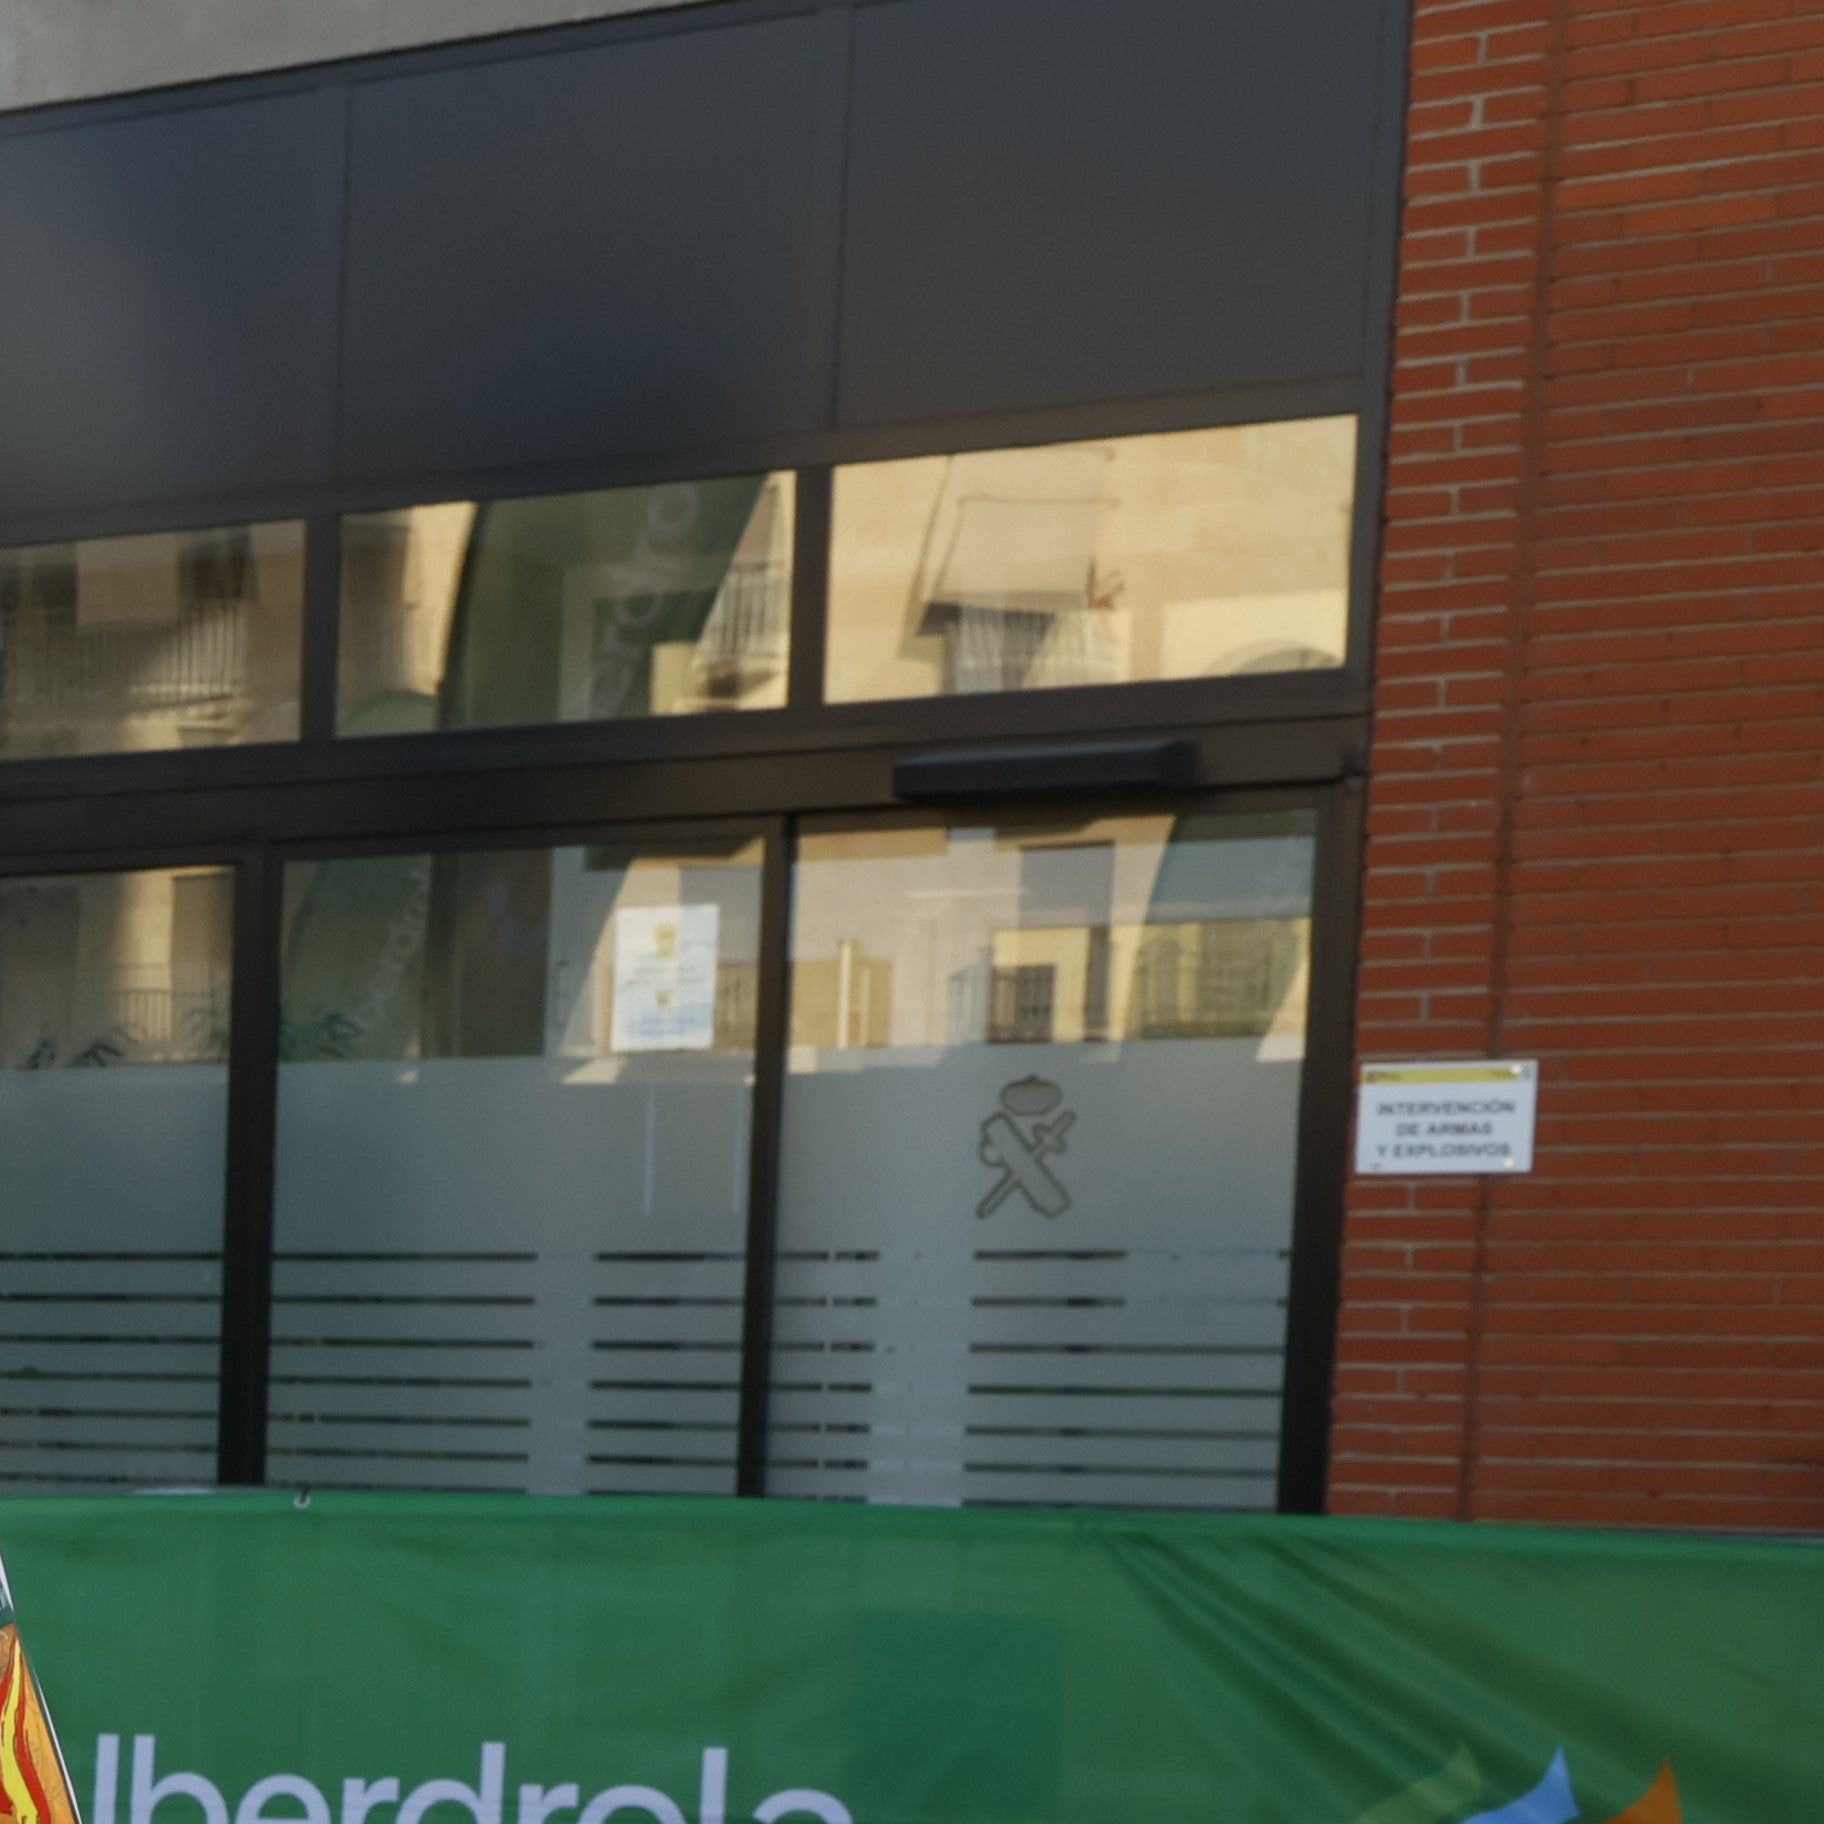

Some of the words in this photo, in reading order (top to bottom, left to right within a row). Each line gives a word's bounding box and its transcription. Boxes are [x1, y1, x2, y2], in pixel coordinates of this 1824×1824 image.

[1396, 1123, 1419, 1137] DE
[1426, 1121, 1493, 1136] ARMAS
[1377, 1144, 1387, 1157] Y
[1393, 1142, 1512, 1159] EXPLOSIVOS
